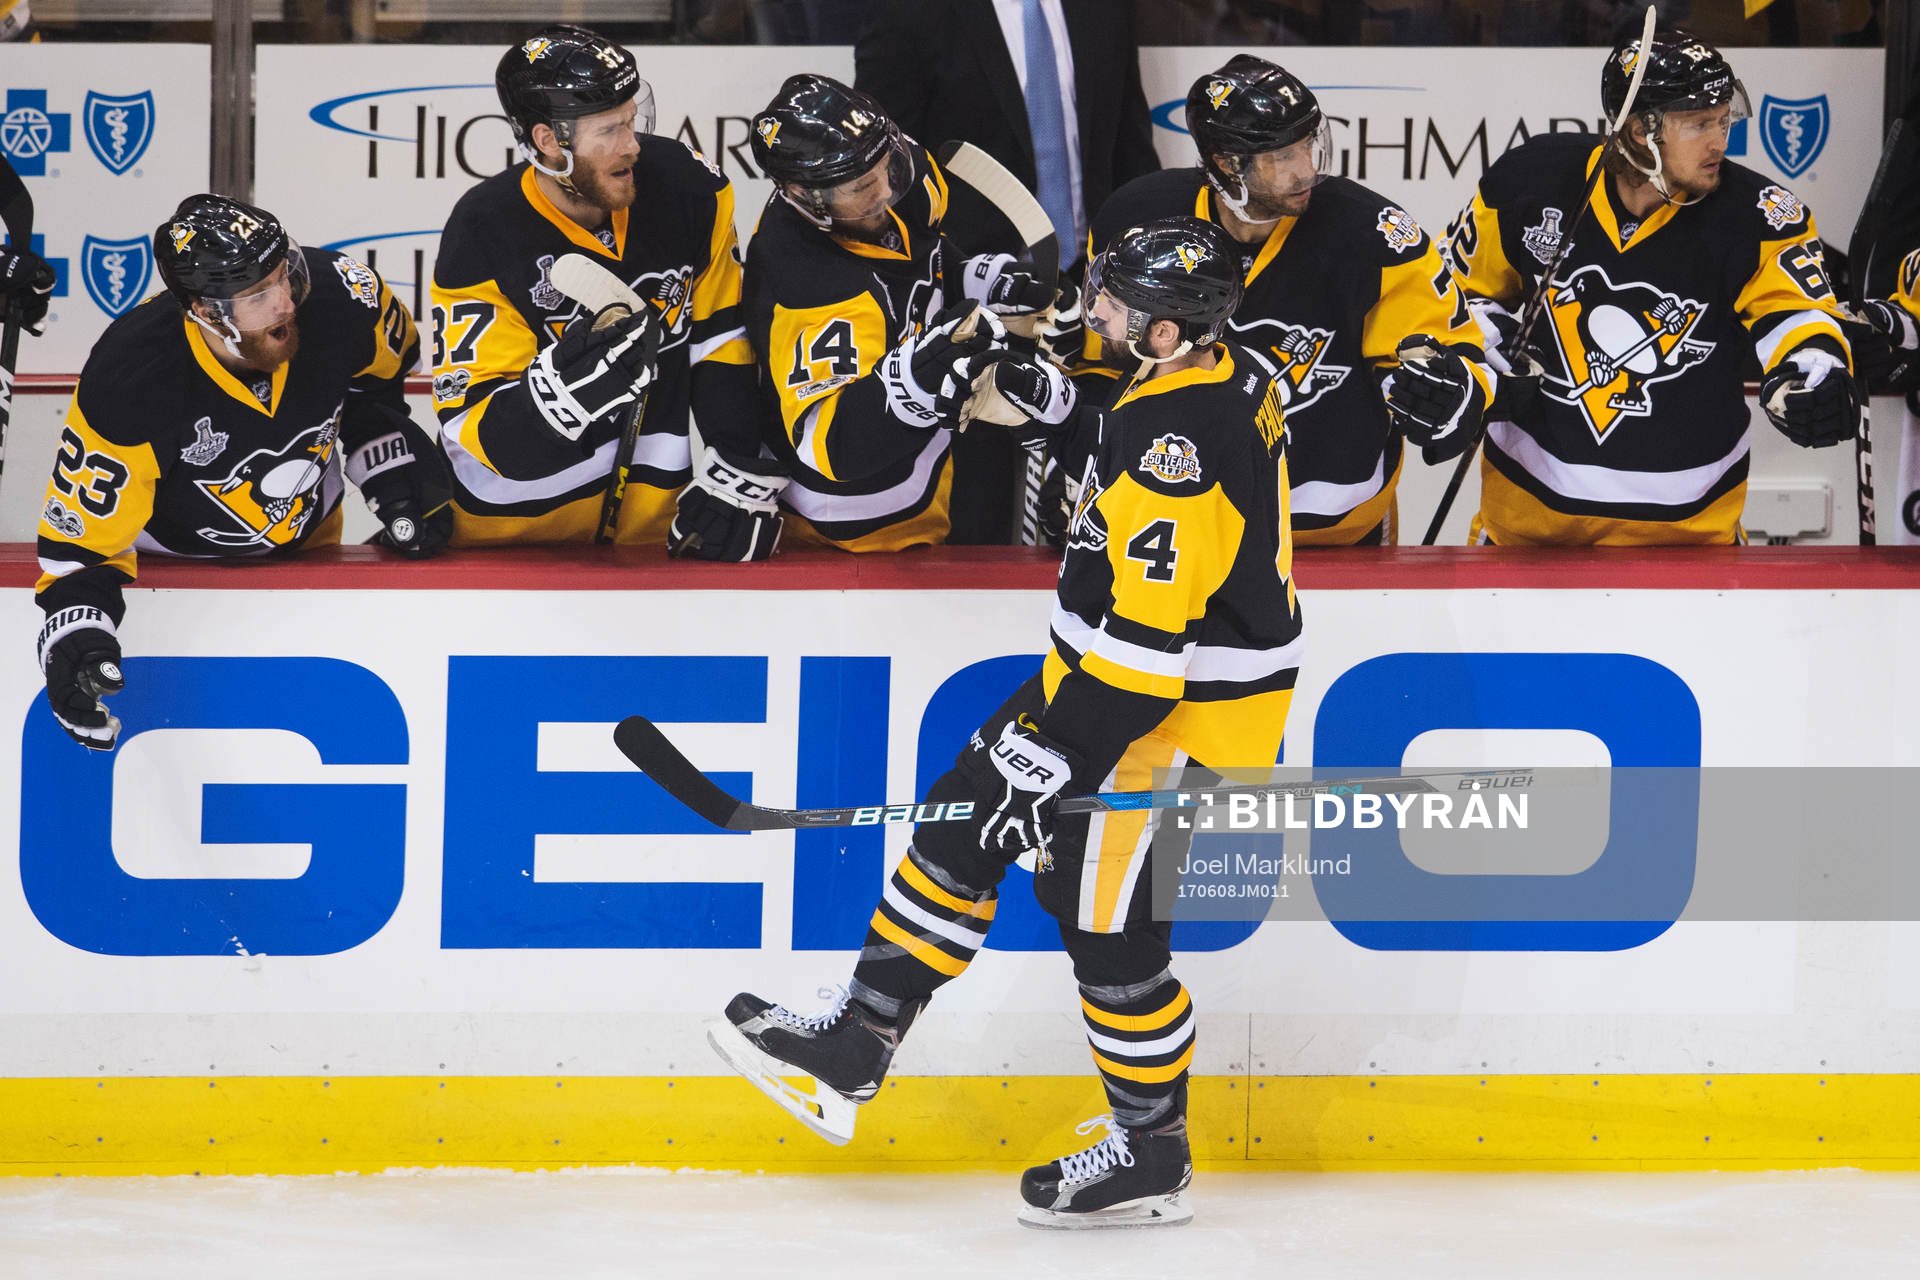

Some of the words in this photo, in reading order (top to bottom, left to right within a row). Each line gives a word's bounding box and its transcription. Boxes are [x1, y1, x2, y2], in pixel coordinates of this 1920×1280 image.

[614, 71, 637, 91] CCM
[1703, 76, 1729, 91] CCM
[1277, 86, 1299, 106] 7
[841, 110, 871, 136] 14
[229, 214, 260, 240] 23
[431, 301, 497, 370] 37
[786, 317, 860, 388] 14
[51, 424, 130, 519] 23
[1148, 453, 1161, 466] 50
[1164, 454, 1195, 472] YEARS
[1125, 519, 1178, 583] 4
[1256, 786, 1328, 800] NEXUS
